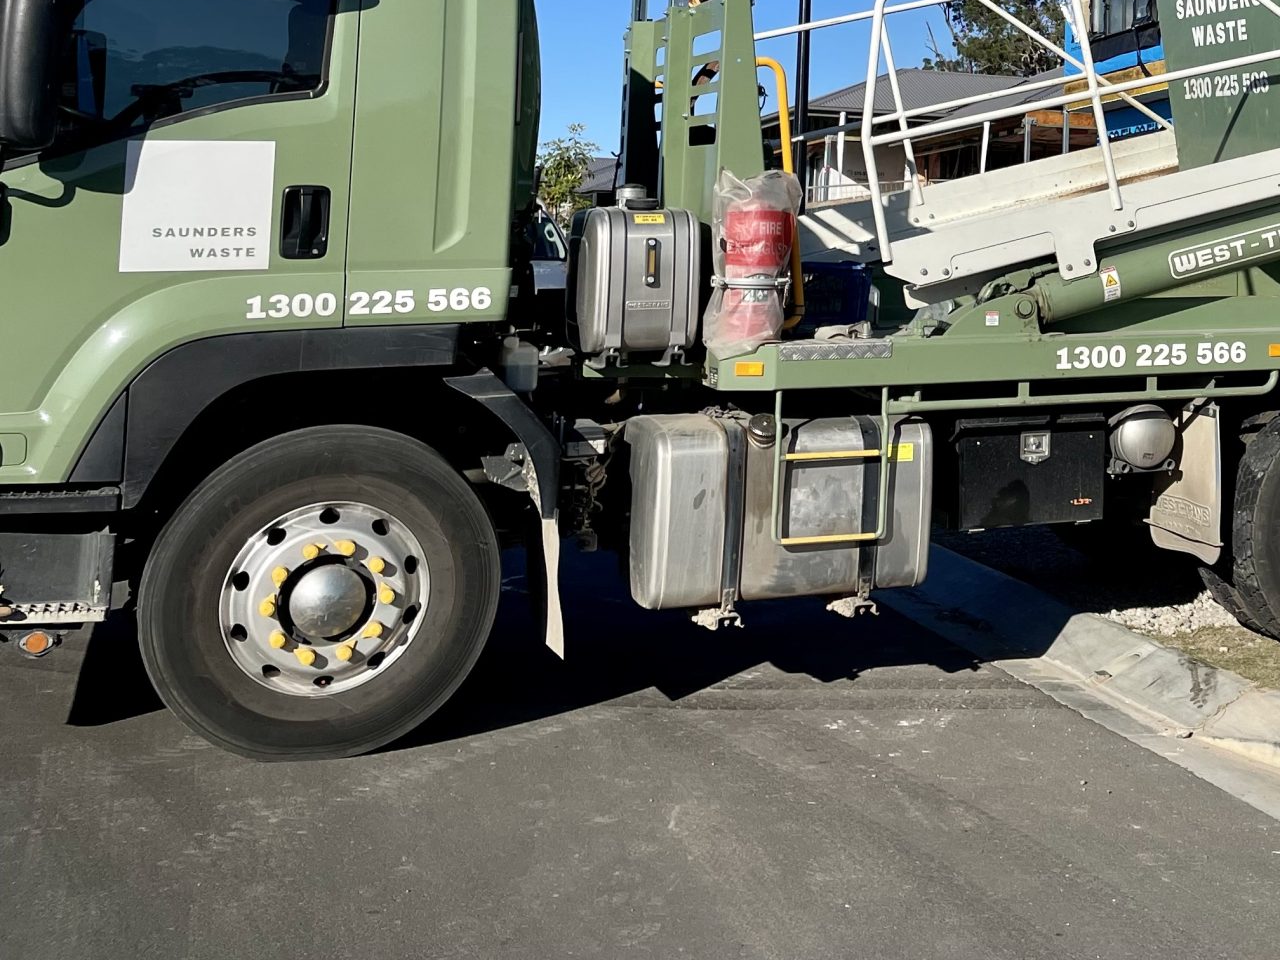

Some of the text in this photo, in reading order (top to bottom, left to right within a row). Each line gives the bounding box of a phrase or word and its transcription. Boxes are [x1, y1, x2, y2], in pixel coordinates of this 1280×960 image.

[1191, 18, 1248, 47] WASTE
[1183, 76, 1212, 100] 1300
[1214, 74, 1239, 97] 225
[152, 227, 258, 239] SAUNDERS
[760, 221, 782, 235] FIRE
[189, 247, 257, 259] WASTE
[246, 286, 493, 320] 1300 225 566
[1056, 341, 1246, 370] 1300 225 566
